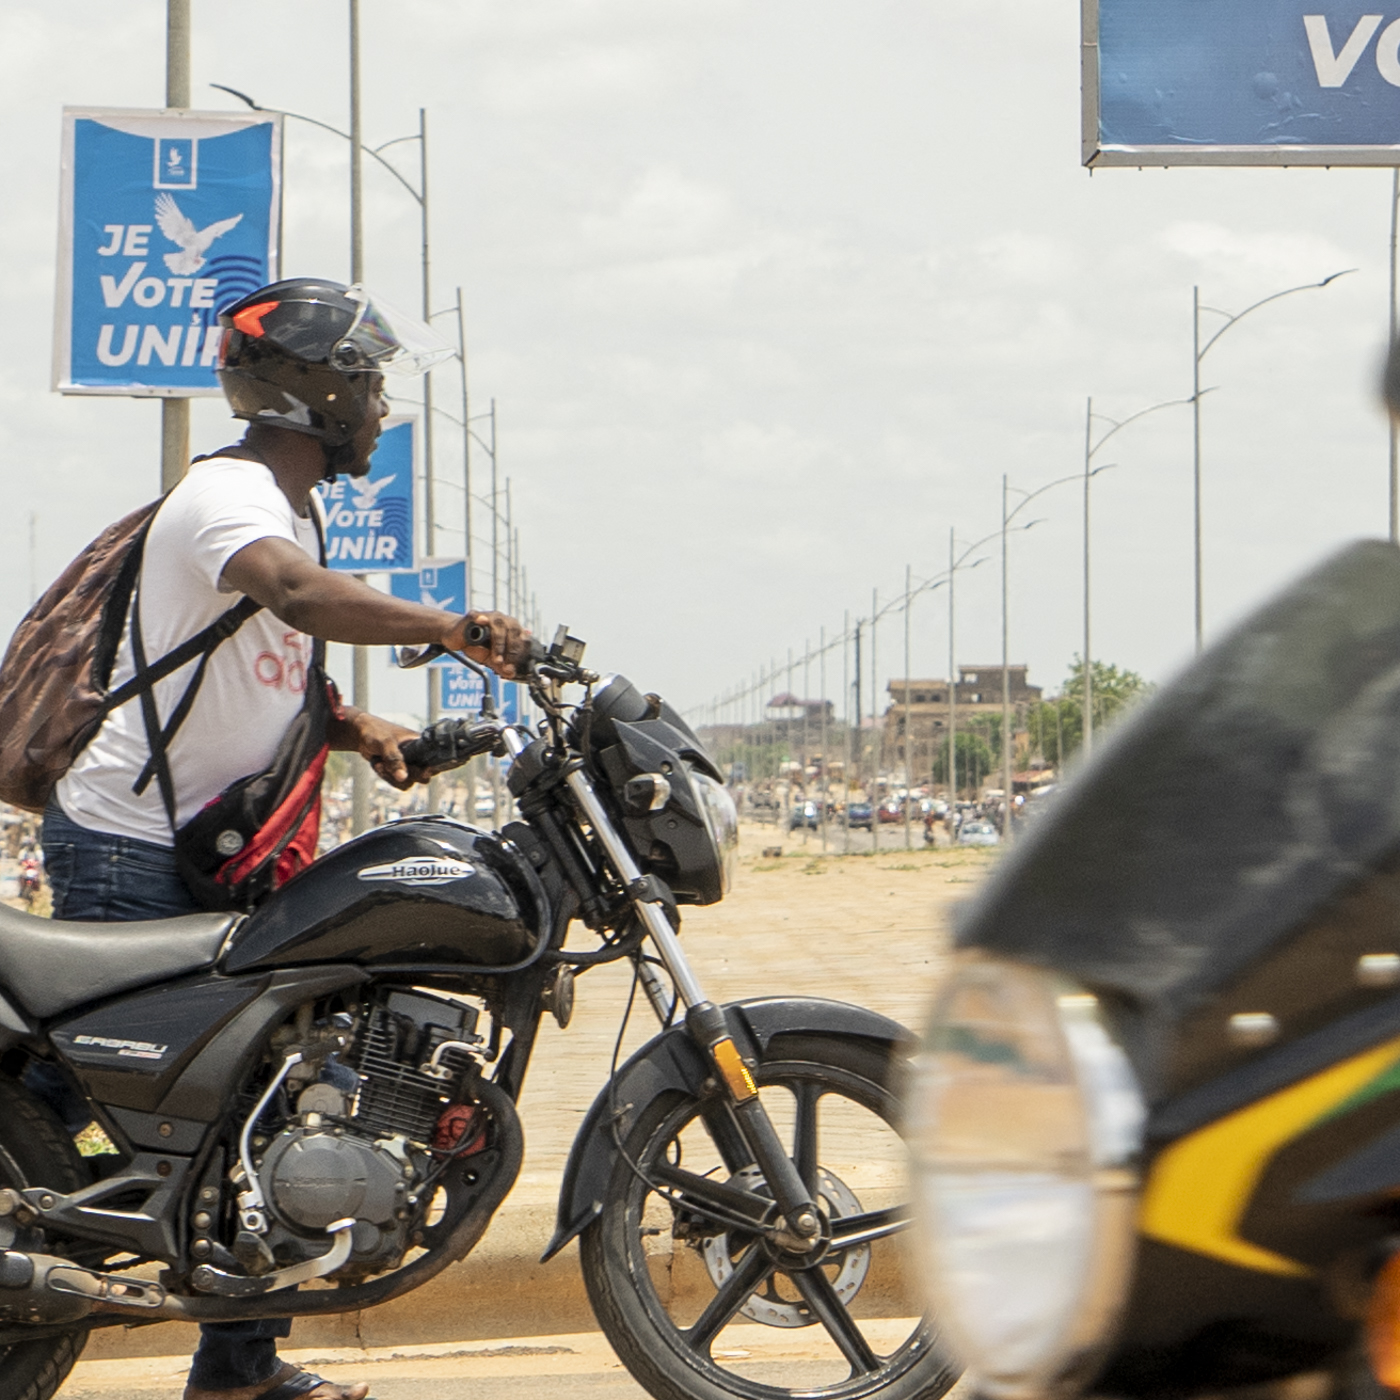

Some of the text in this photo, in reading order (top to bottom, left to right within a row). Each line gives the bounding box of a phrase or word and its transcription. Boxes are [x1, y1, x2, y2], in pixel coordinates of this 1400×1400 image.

[97, 224, 153, 256] JE
[100, 261, 219, 308] VOTE
[448, 693, 484, 707] UNI
